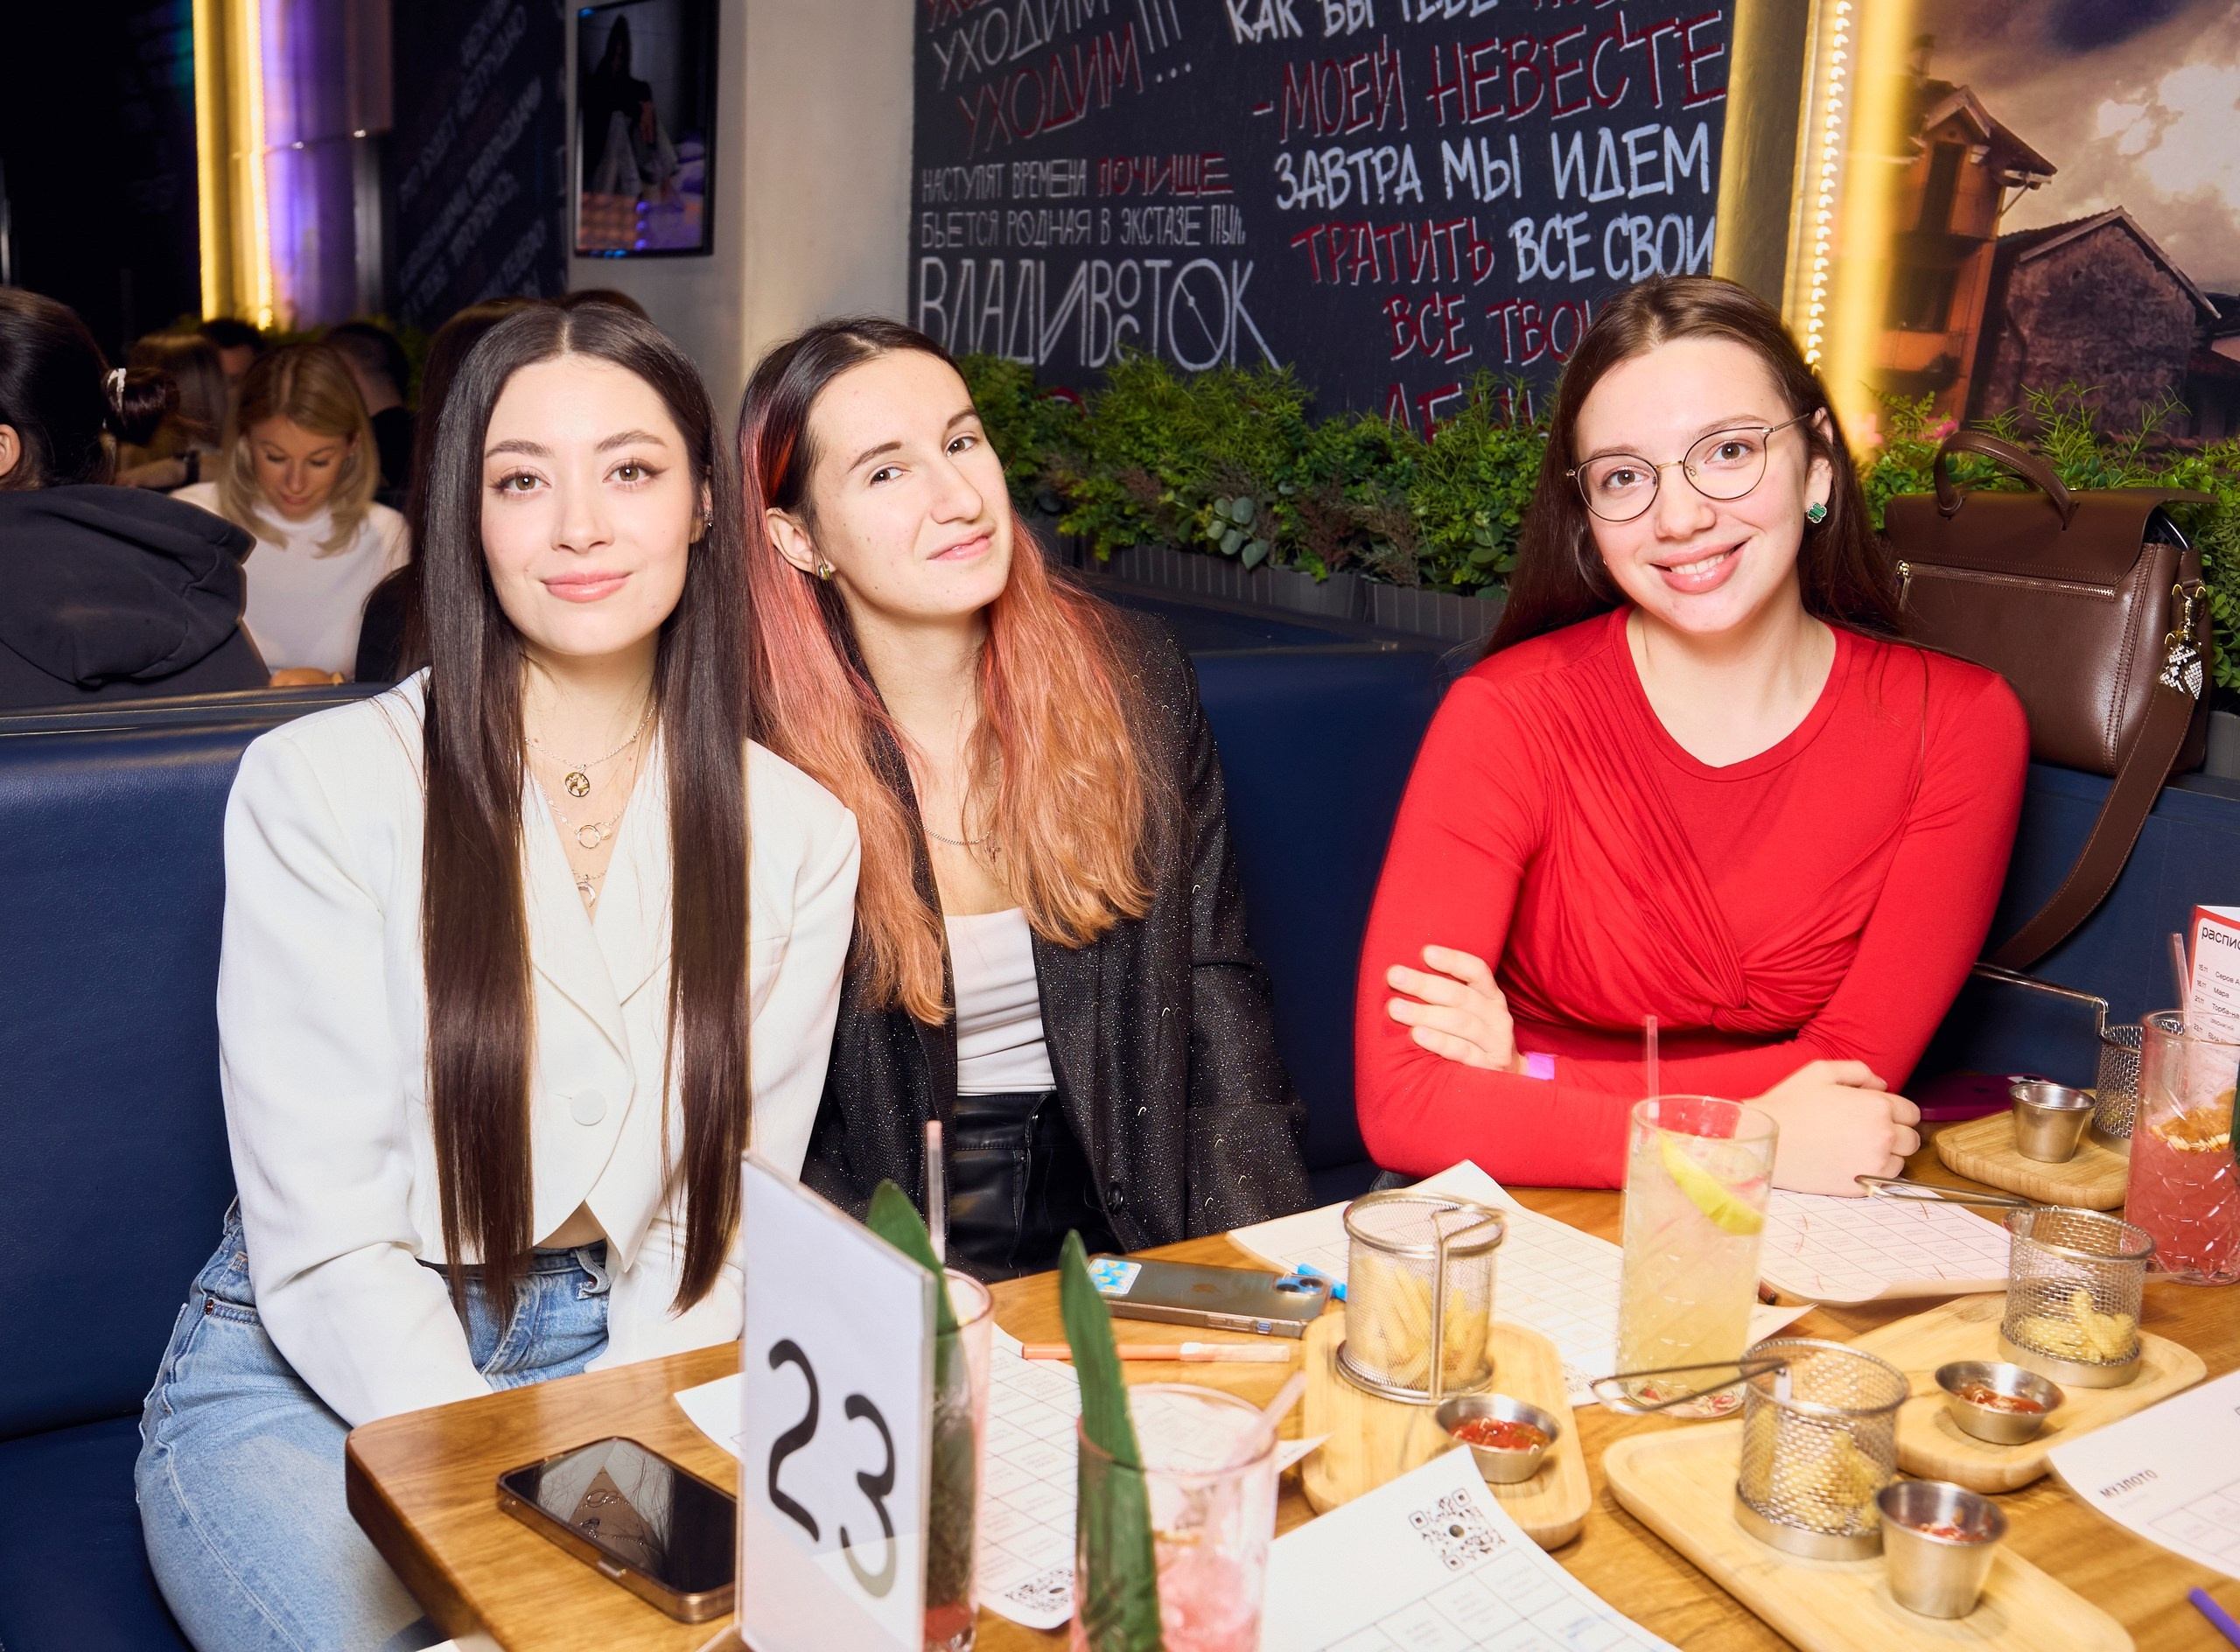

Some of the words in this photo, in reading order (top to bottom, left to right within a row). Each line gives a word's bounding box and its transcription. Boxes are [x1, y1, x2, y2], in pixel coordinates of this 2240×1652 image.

[1425, 10, 1727, 127] НЕВЕСТЕ
[1097, 151, 1235, 199] ПОЧИЩЕ
[1273, 143, 1424, 210] ЗАВТРА
[1440, 132, 1522, 203] МЫ
[1550, 121, 1712, 203] ИДЕМ
[1006, 207, 1091, 249] РОДНАЯ
[1100, 207, 1112, 246] В
[1119, 205, 1205, 246] ЭКСТАЗЕ
[1290, 216, 1495, 287] ТРАТИТЬ
[1508, 211, 1597, 284] ВСЕ
[1382, 291, 1474, 364] ВСЕ
[2212, 987, 2230, 999] Мара
[767, 1339, 897, 1600] 23
